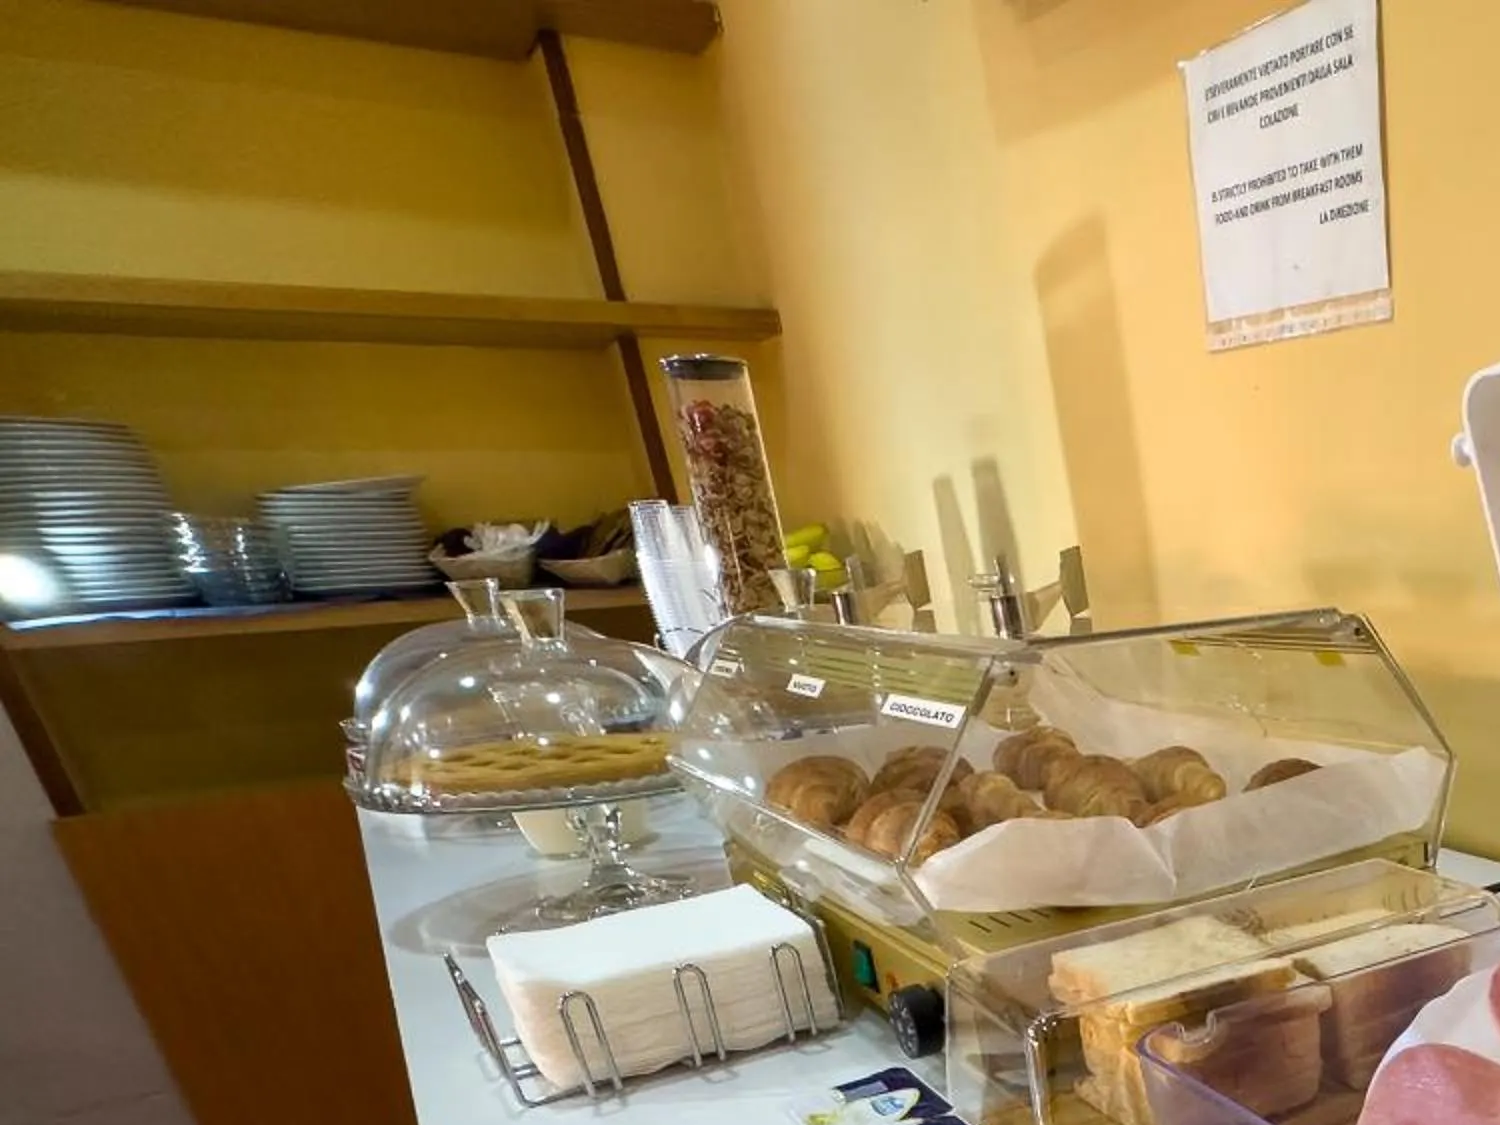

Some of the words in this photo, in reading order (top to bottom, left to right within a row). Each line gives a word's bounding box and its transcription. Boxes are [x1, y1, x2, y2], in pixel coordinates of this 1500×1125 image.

[1258, 53, 1289, 77] VIETATO
[1290, 36, 1324, 63] PORTARE
[1326, 30, 1342, 49] CON
[1333, 54, 1354, 74] SALA
[1287, 164, 1298, 178] TO
[1299, 158, 1319, 174] TAKE
[1320, 151, 1340, 169] WITH
[1340, 143, 1363, 162] THEM
[1271, 191, 1291, 208] FROM
[1292, 178, 1333, 203] BREAKFAST
[1319, 210, 1328, 224] LA
[1330, 199, 1369, 221] DIREZIONE
[889, 702, 955, 723] CIOCCOLATO
